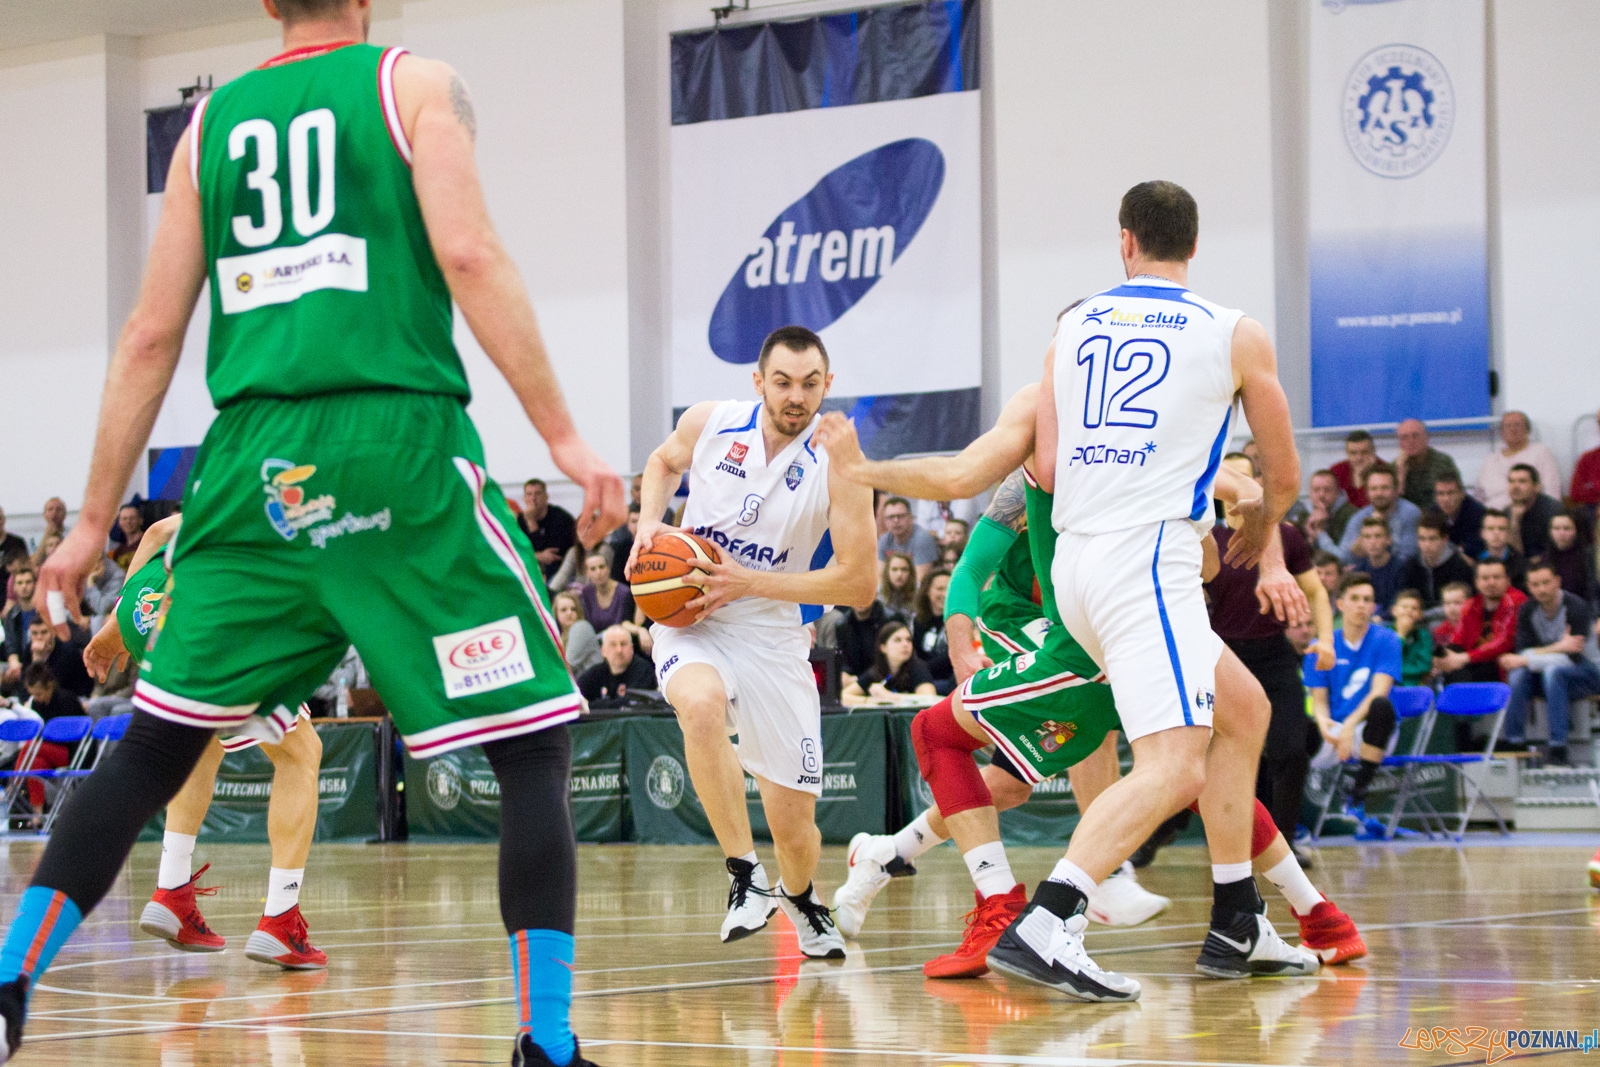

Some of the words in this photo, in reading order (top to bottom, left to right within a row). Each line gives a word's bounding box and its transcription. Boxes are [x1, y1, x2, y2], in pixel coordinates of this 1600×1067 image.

[228, 107, 336, 248] 30
[745, 221, 896, 288] atrem
[1111, 308, 1188, 325] funclub
[1077, 335, 1171, 429] 12
[737, 493, 765, 527] 8
[464, 636, 504, 658] ELE
[659, 654, 680, 680] PBG
[801, 737, 819, 773] 8
[1019, 734, 1043, 762] BEMOWO
